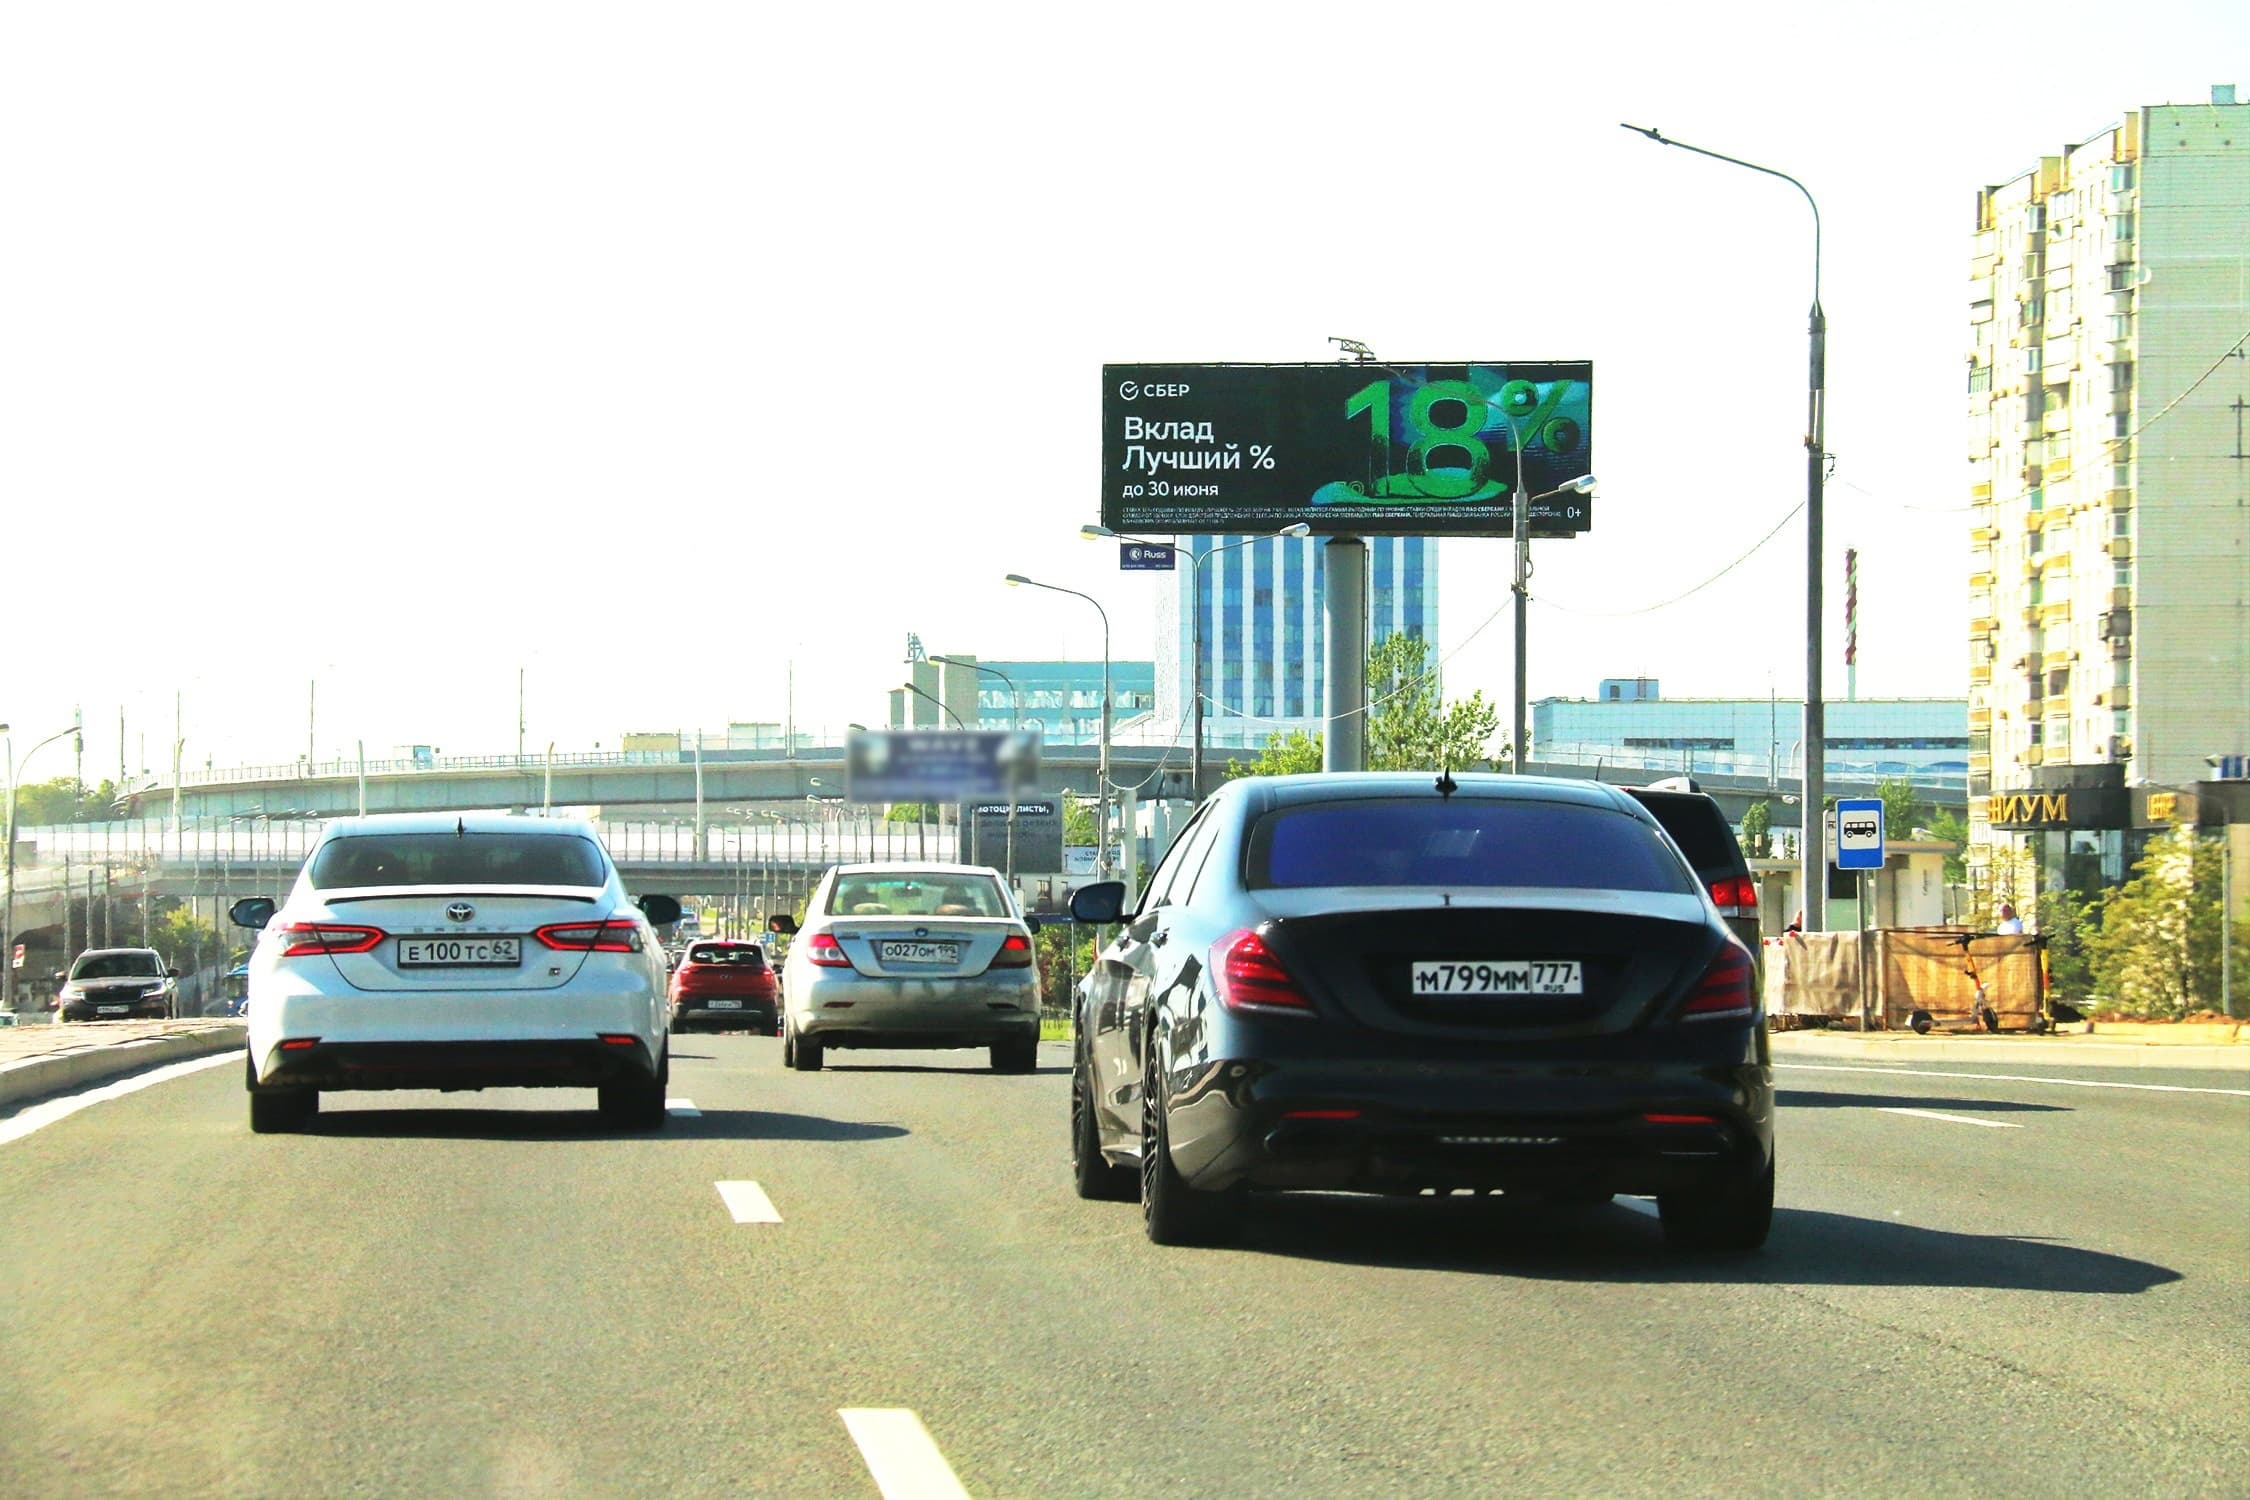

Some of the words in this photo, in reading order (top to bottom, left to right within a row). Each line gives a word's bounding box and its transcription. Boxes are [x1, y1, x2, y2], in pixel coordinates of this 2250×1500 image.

[1143, 383, 1190, 397] СБЕР
[1124, 416, 1215, 444] Вклад
[1121, 443, 1241, 476] Лучший
[1249, 445, 1276, 470] %
[1122, 485, 1144, 499] до
[1148, 481, 1169, 496] 30
[1173, 485, 1219, 496] июня
[1566, 506, 1582, 519] 0+
[1143, 550, 1167, 559] Russ
[493, 941, 512, 955] 62
[1419, 965, 1529, 991] М799ММ
[1533, 964, 1573, 983] 777
[1543, 984, 1565, 992] RUS
